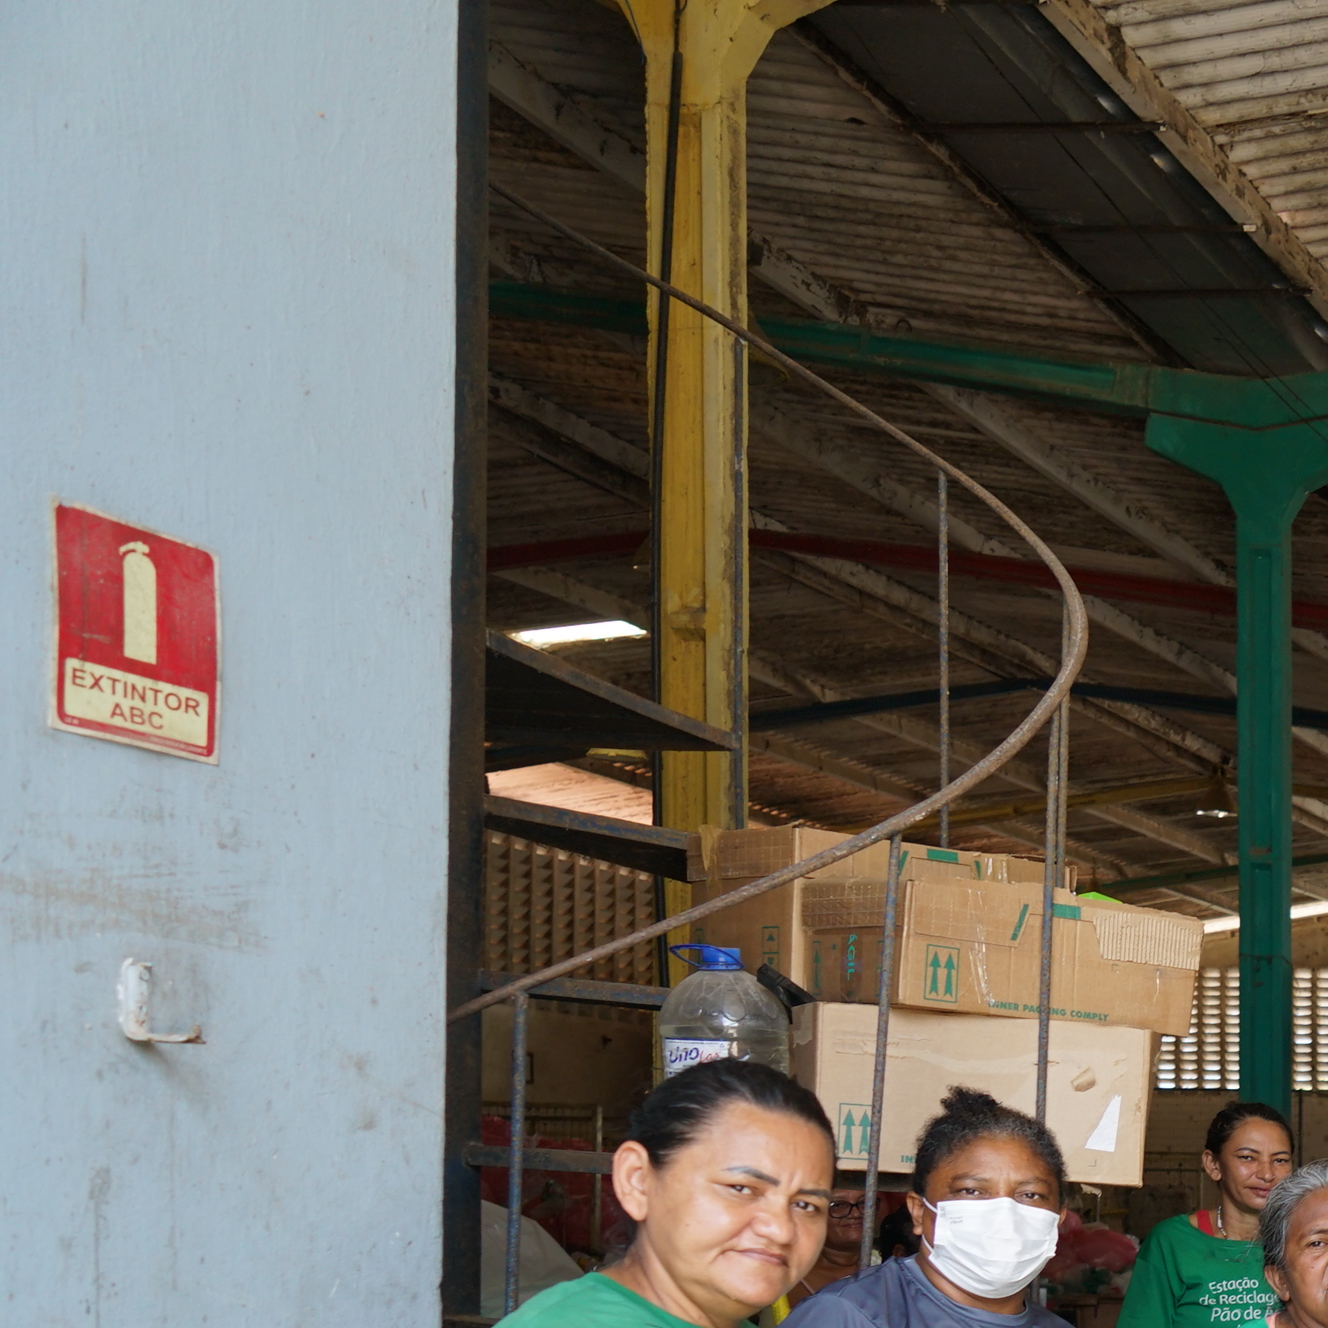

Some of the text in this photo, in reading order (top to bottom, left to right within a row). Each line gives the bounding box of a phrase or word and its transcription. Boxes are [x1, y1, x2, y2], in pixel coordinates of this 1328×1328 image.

[71, 667, 201, 717] EXTINTOR
[110, 702, 164, 730] ABC
[1022, 1003, 1067, 1016] PACING
[1070, 1009, 1110, 1022] COMPLY
[1208, 1276, 1260, 1295] Estação
[1199, 1290, 1280, 1306] de Reciclag
[1210, 1307, 1242, 1322] Pão
[1243, 1305, 1262, 1320] de
